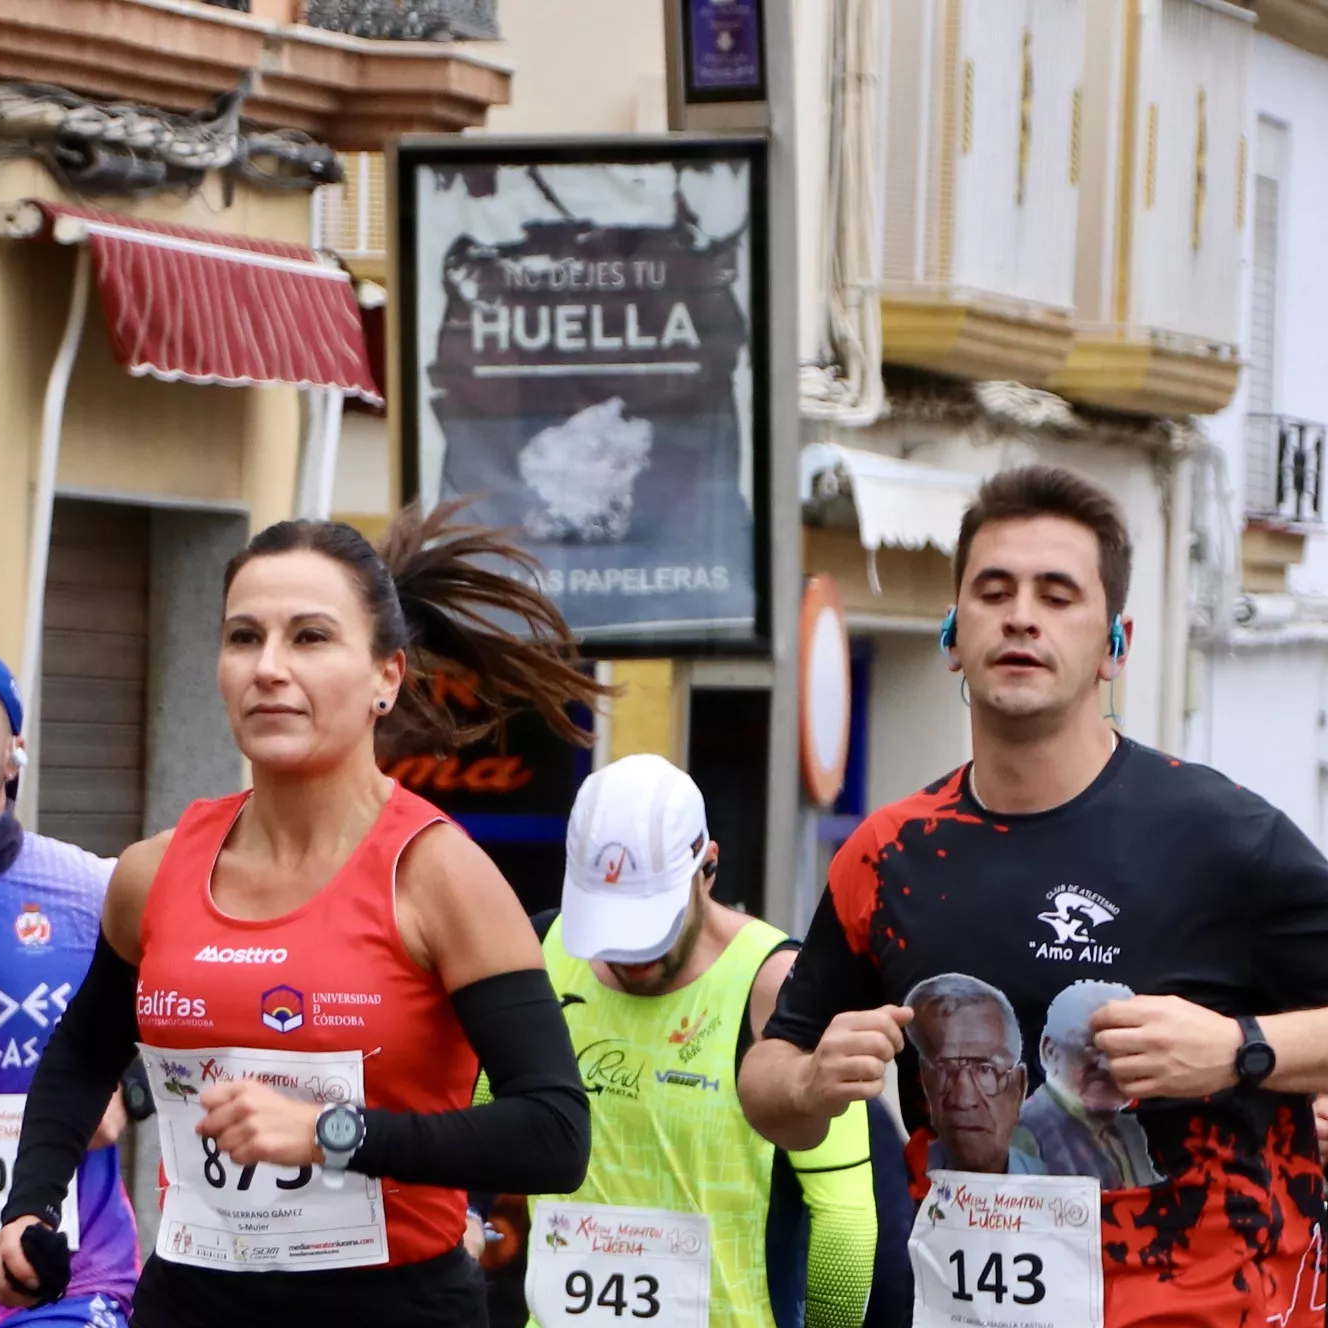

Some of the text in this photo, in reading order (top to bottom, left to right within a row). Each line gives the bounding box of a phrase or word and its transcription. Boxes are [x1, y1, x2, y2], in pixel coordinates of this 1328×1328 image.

[549, 260, 625, 288] DEJES
[633, 261, 667, 287] TU
[473, 302, 702, 352] HUELLA
[571, 565, 730, 595] PAPELERAS
[1046, 883, 1121, 916] CLUB DE ATLETISMO
[194, 944, 288, 964] Mosttro
[137, 990, 207, 1018] califas
[312, 992, 382, 1005] UNIVERSIDAD
[313, 1012, 365, 1027] CÓRDOBA
[232, 1209, 270, 1219] SERRANO
[968, 1211, 1027, 1232] LUCENA
[592, 1235, 649, 1257] LUCENA
[948, 1248, 1047, 1305] 143
[564, 1269, 661, 1319] 943
